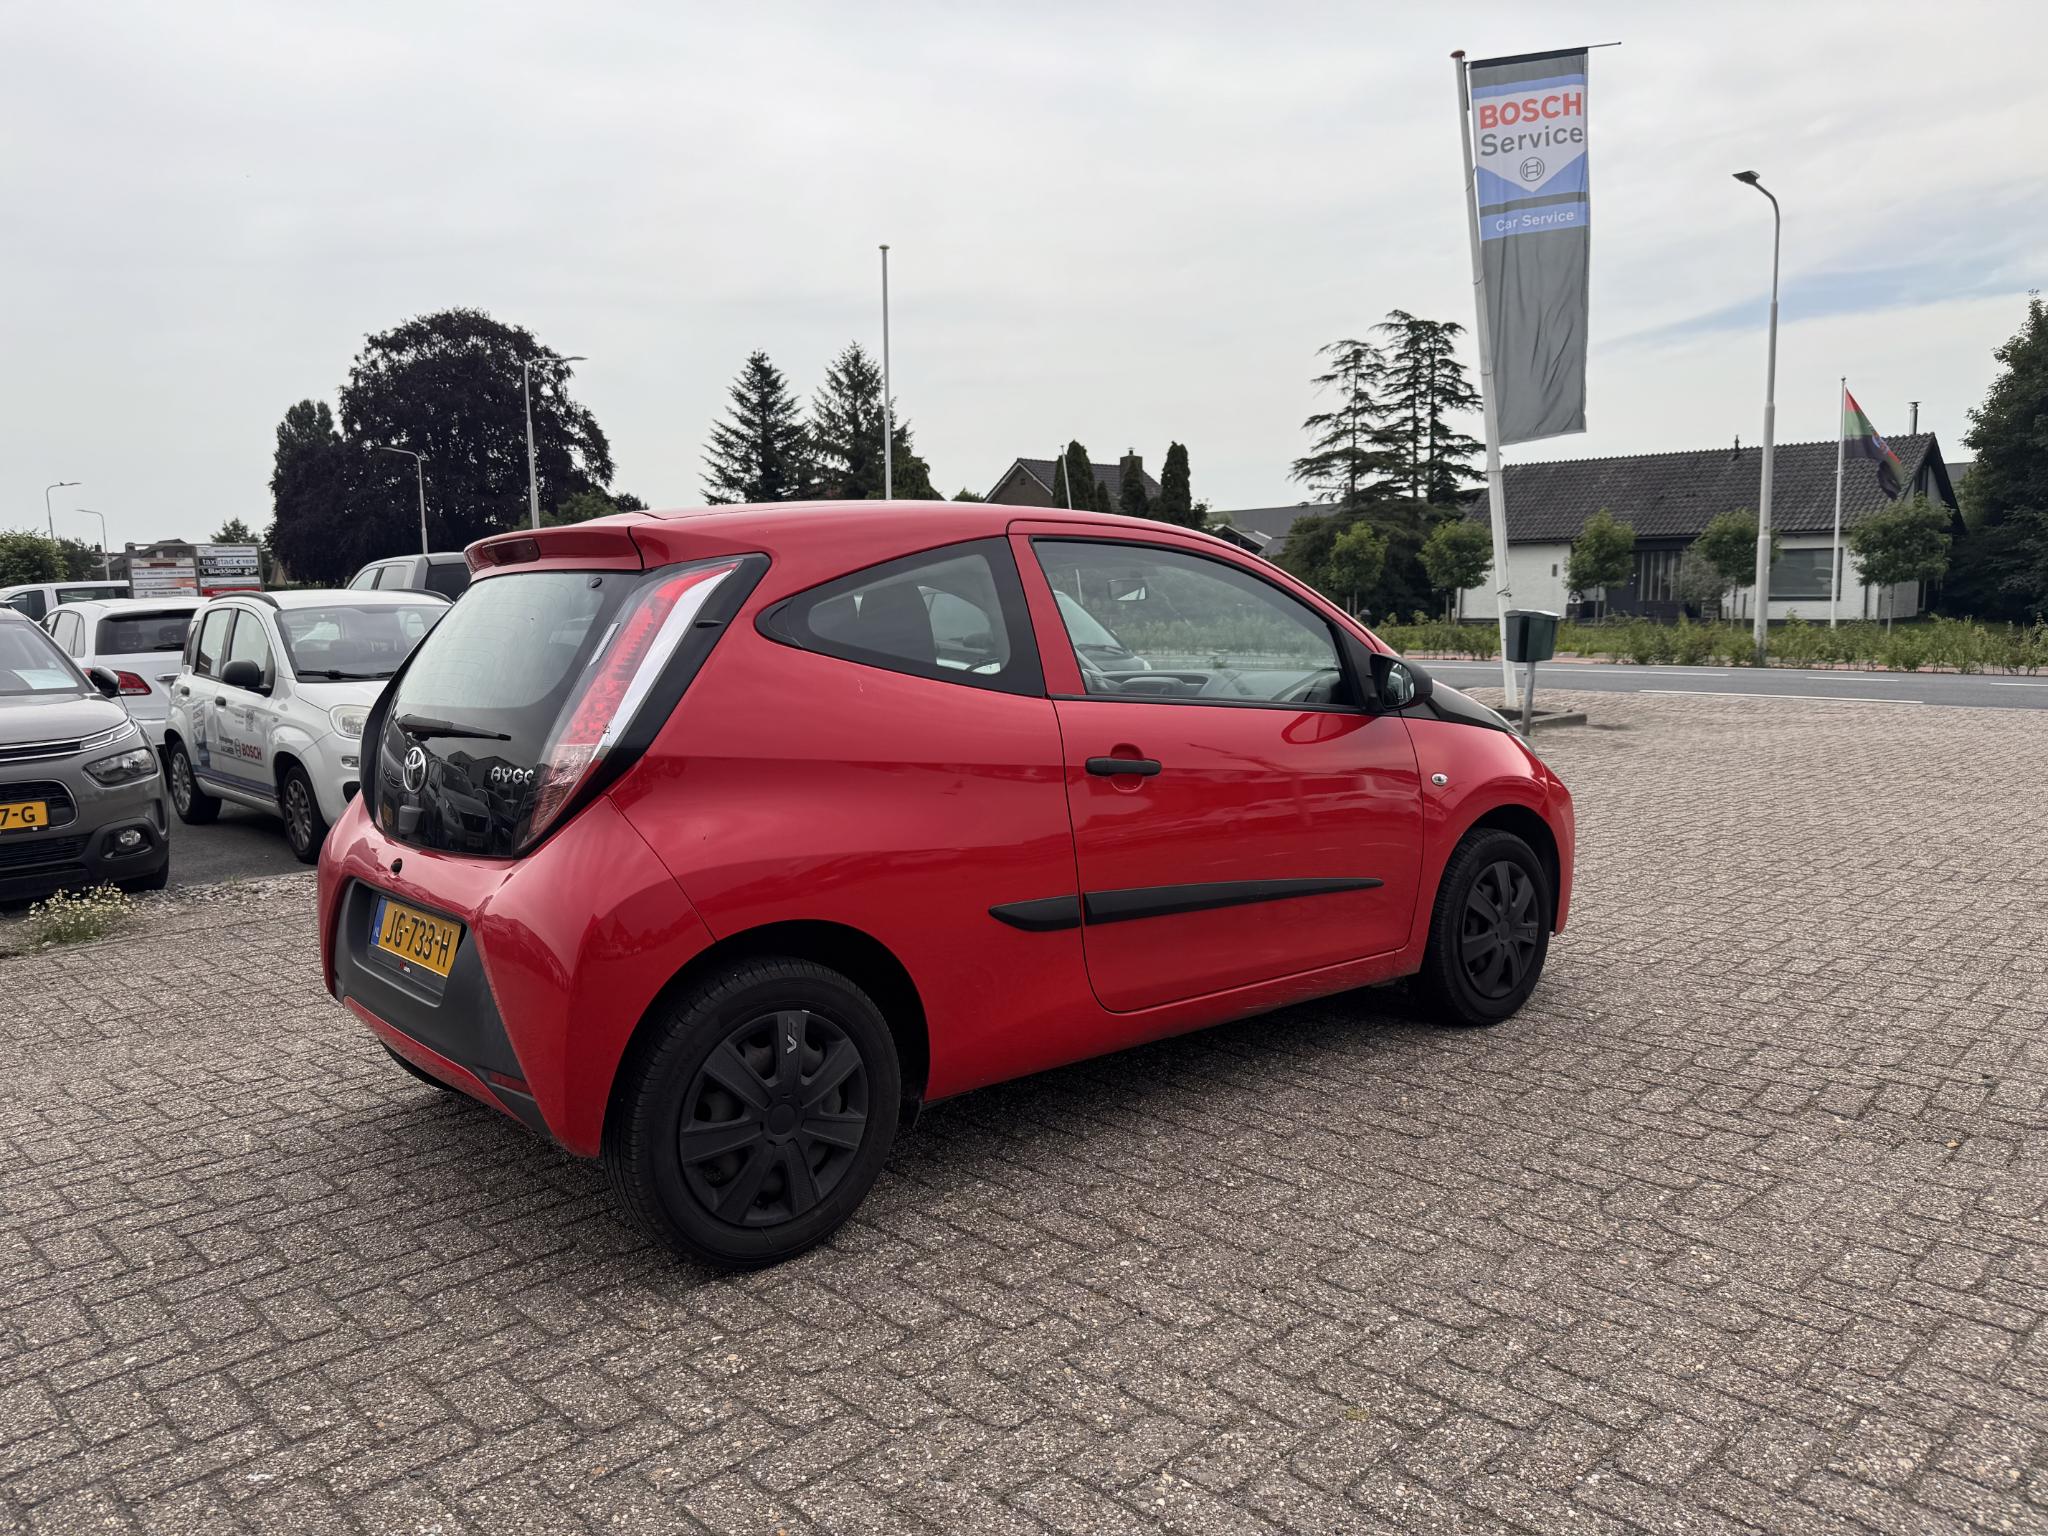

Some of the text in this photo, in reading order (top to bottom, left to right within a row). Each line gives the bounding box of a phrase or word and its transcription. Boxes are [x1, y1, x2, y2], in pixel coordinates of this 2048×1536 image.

[1479, 92, 1582, 129] BOSCH
[1480, 125, 1583, 156] Service
[1496, 210, 1575, 232] Car Service
[241, 743, 262, 761] BOSCH
[385, 909, 453, 967] JG-733-H
